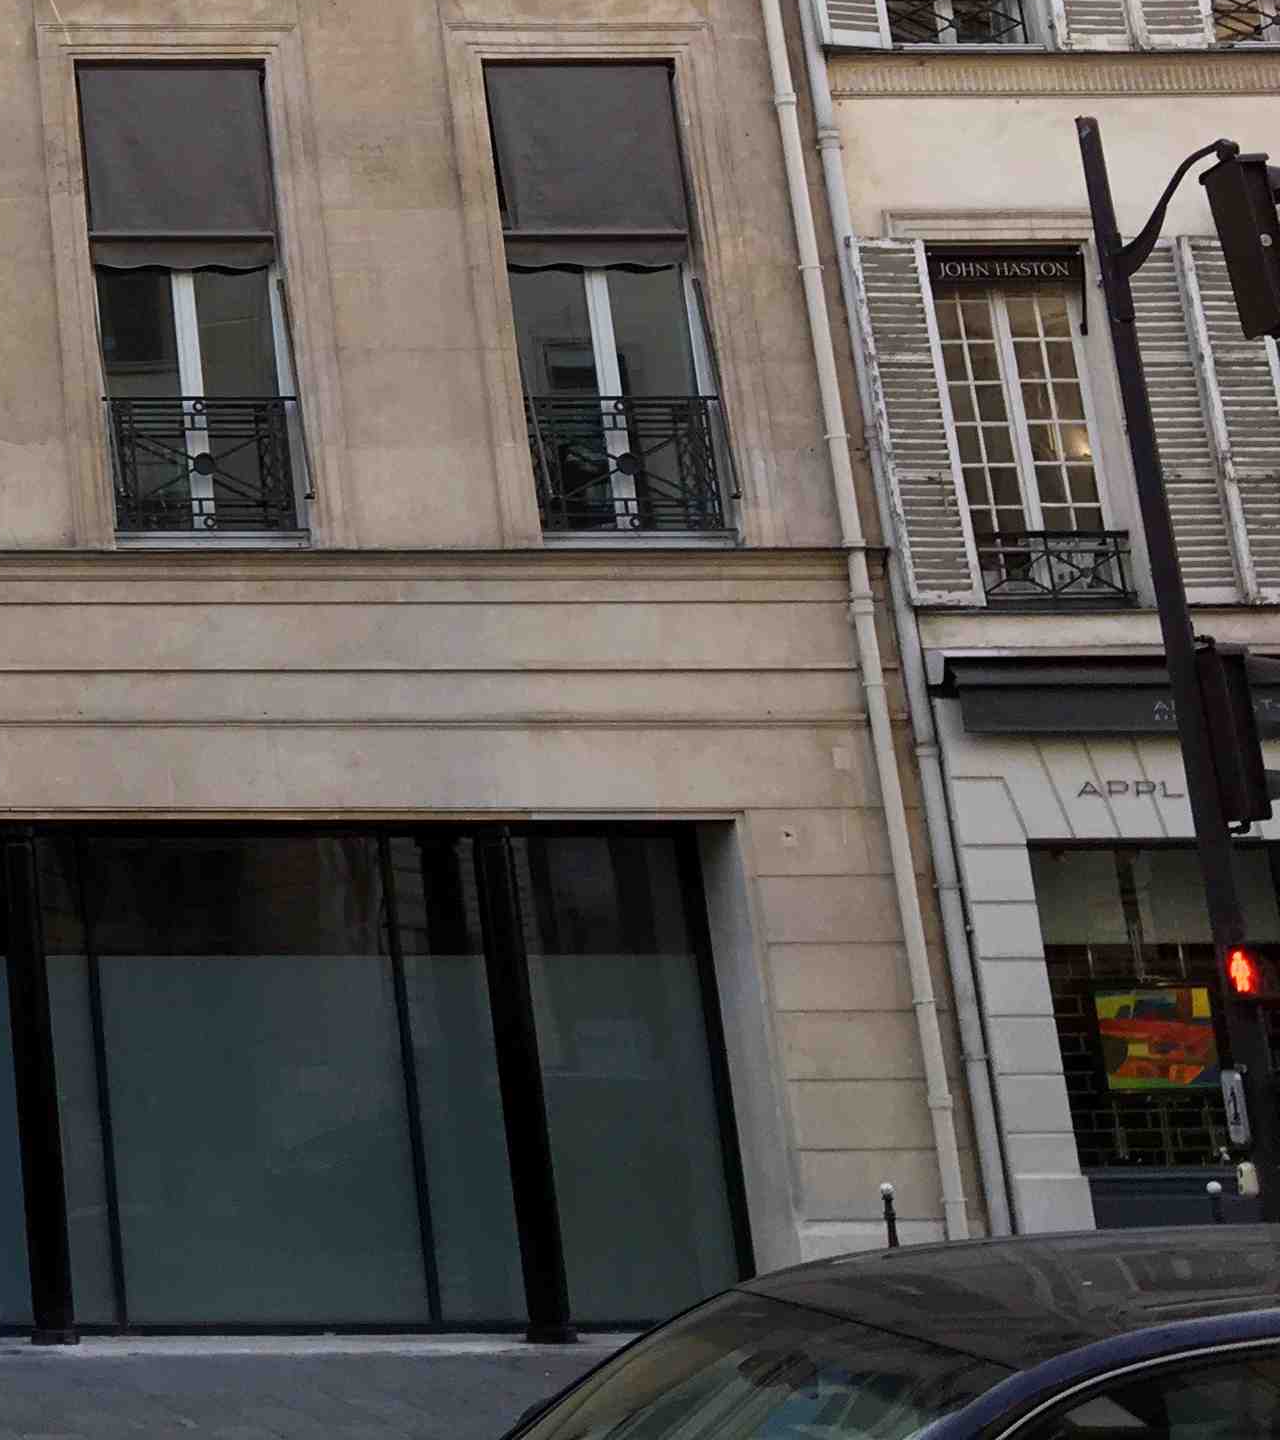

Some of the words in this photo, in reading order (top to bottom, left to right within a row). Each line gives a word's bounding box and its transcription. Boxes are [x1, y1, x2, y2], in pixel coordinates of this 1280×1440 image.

[940, 262, 990, 278] JOHN
[995, 262, 1070, 277] HASTON
[1077, 780, 1184, 799] APPL
